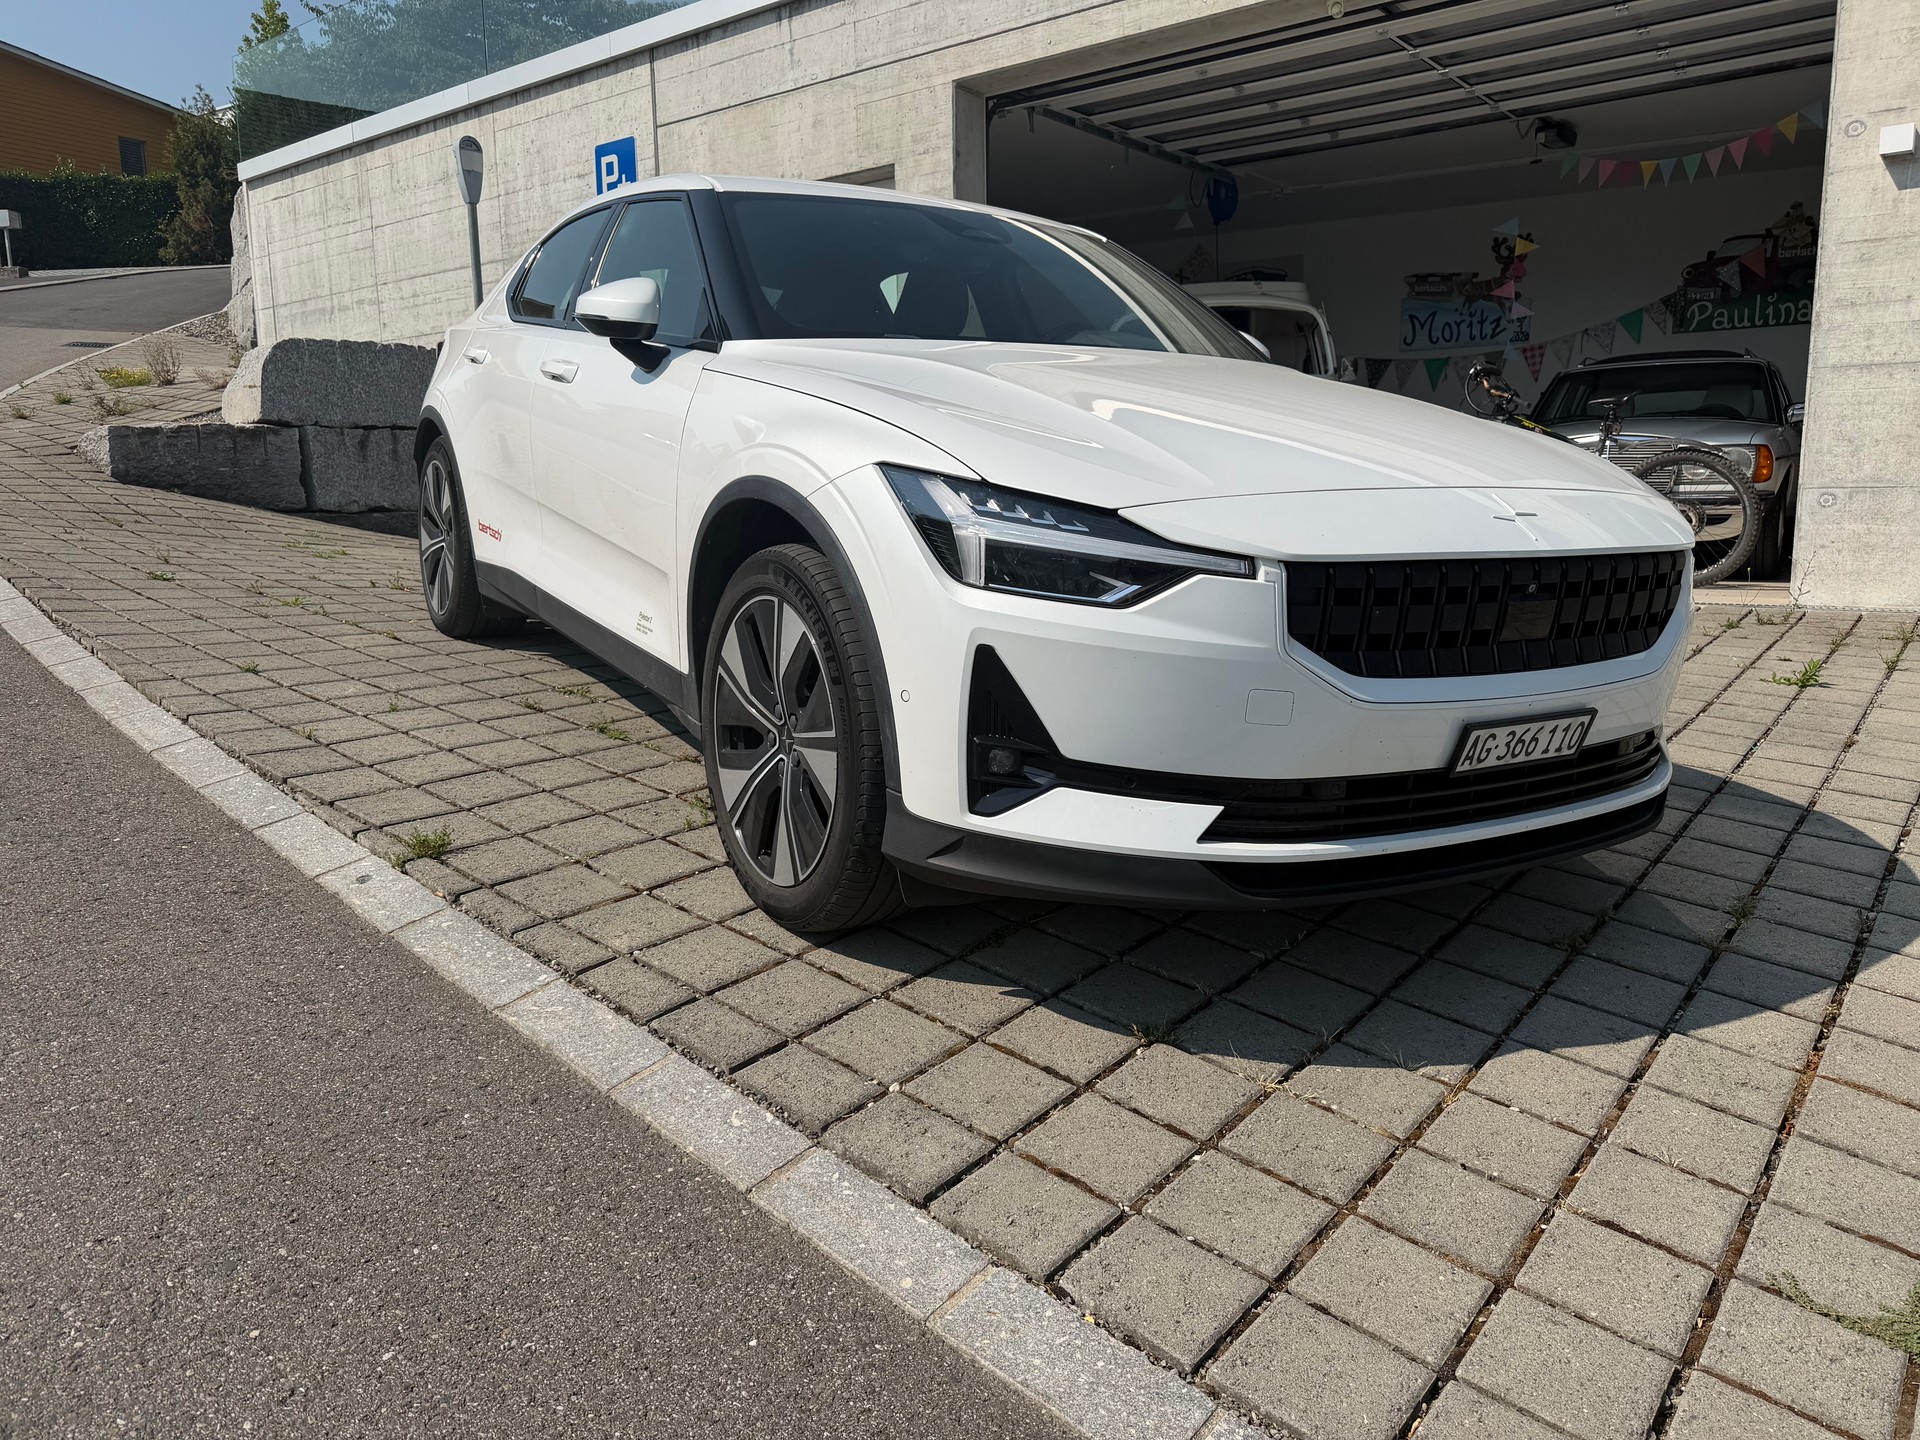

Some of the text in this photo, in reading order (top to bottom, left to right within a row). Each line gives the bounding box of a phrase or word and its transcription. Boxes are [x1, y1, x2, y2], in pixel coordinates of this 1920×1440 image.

[1403, 308, 1507, 346] Moritz
[1687, 292, 1811, 331] Paulina
[478, 518, 503, 542] bertschi
[786, 575, 840, 680] MICHELIN
